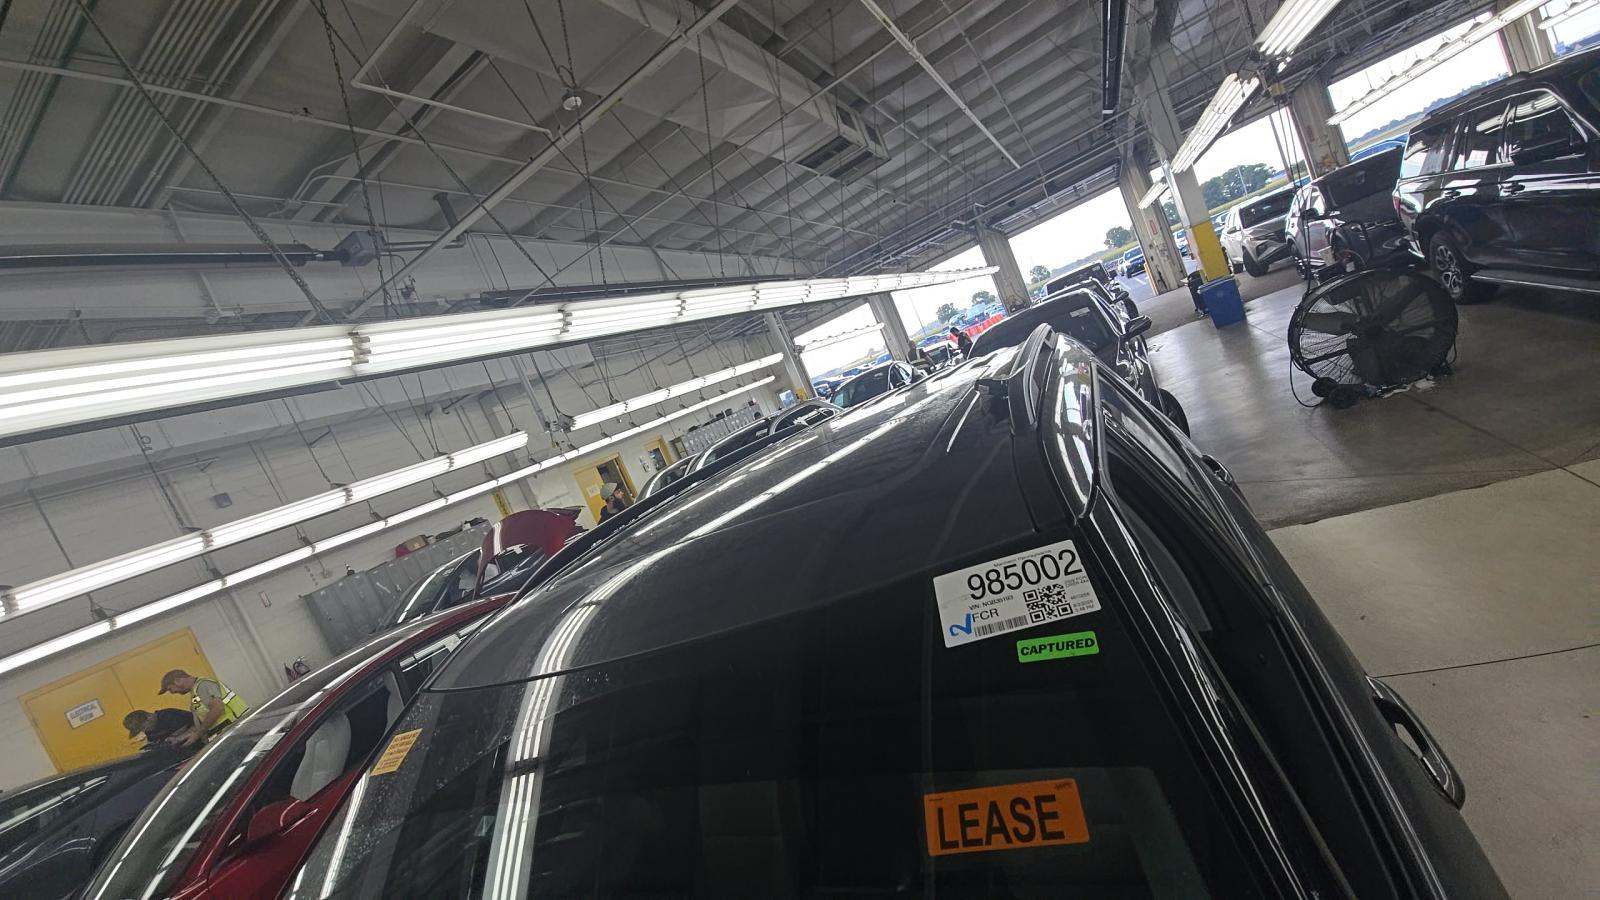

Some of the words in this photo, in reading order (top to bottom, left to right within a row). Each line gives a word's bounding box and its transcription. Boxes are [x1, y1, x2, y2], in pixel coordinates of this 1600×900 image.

[967, 549, 1083, 600] 985002
[971, 608, 999, 622] FCR
[1020, 638, 1095, 656] CAPTURED
[937, 795, 1065, 849] LEASE
